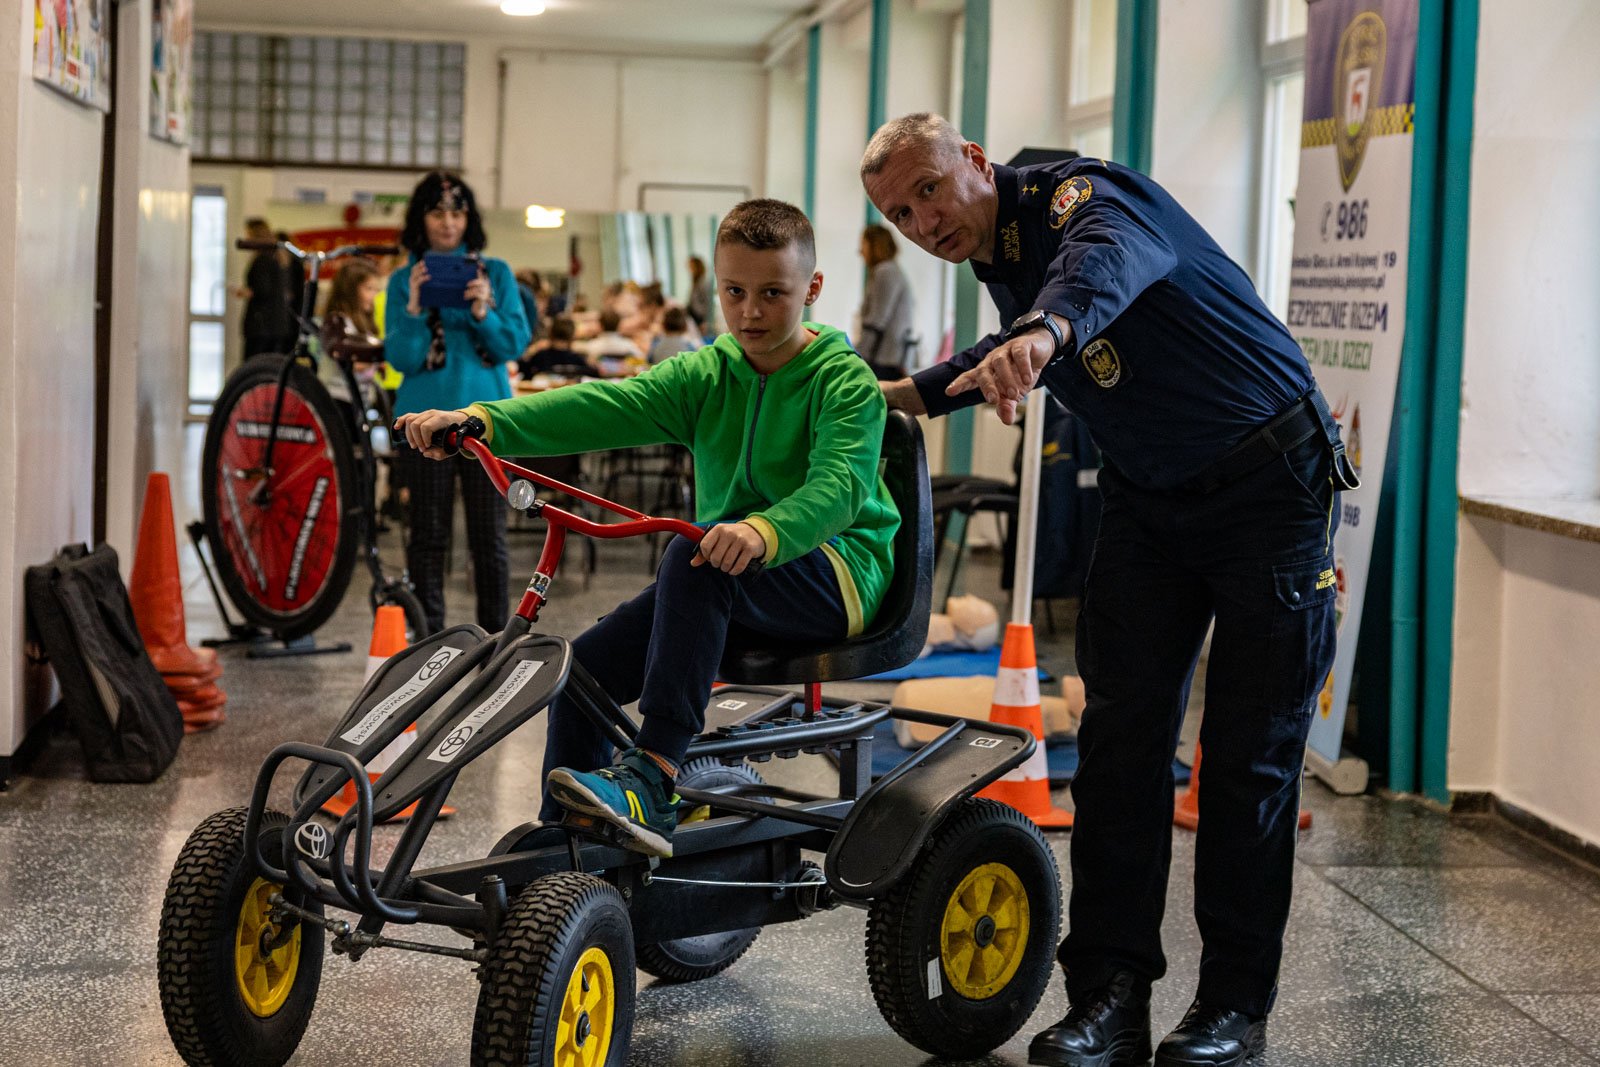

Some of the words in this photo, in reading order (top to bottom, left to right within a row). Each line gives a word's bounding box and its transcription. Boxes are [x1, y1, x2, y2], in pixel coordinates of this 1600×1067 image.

[1337, 200, 1369, 239] 986
[1000, 226, 1012, 260] STRAŻ
[1010, 220, 1021, 262] MIEJSKA
[1384, 251, 1396, 267] 19
[1288, 300, 1348, 329] EZPIECZNIE
[473, 661, 533, 719] Nowakowski
[352, 687, 417, 744] Nowakowski
